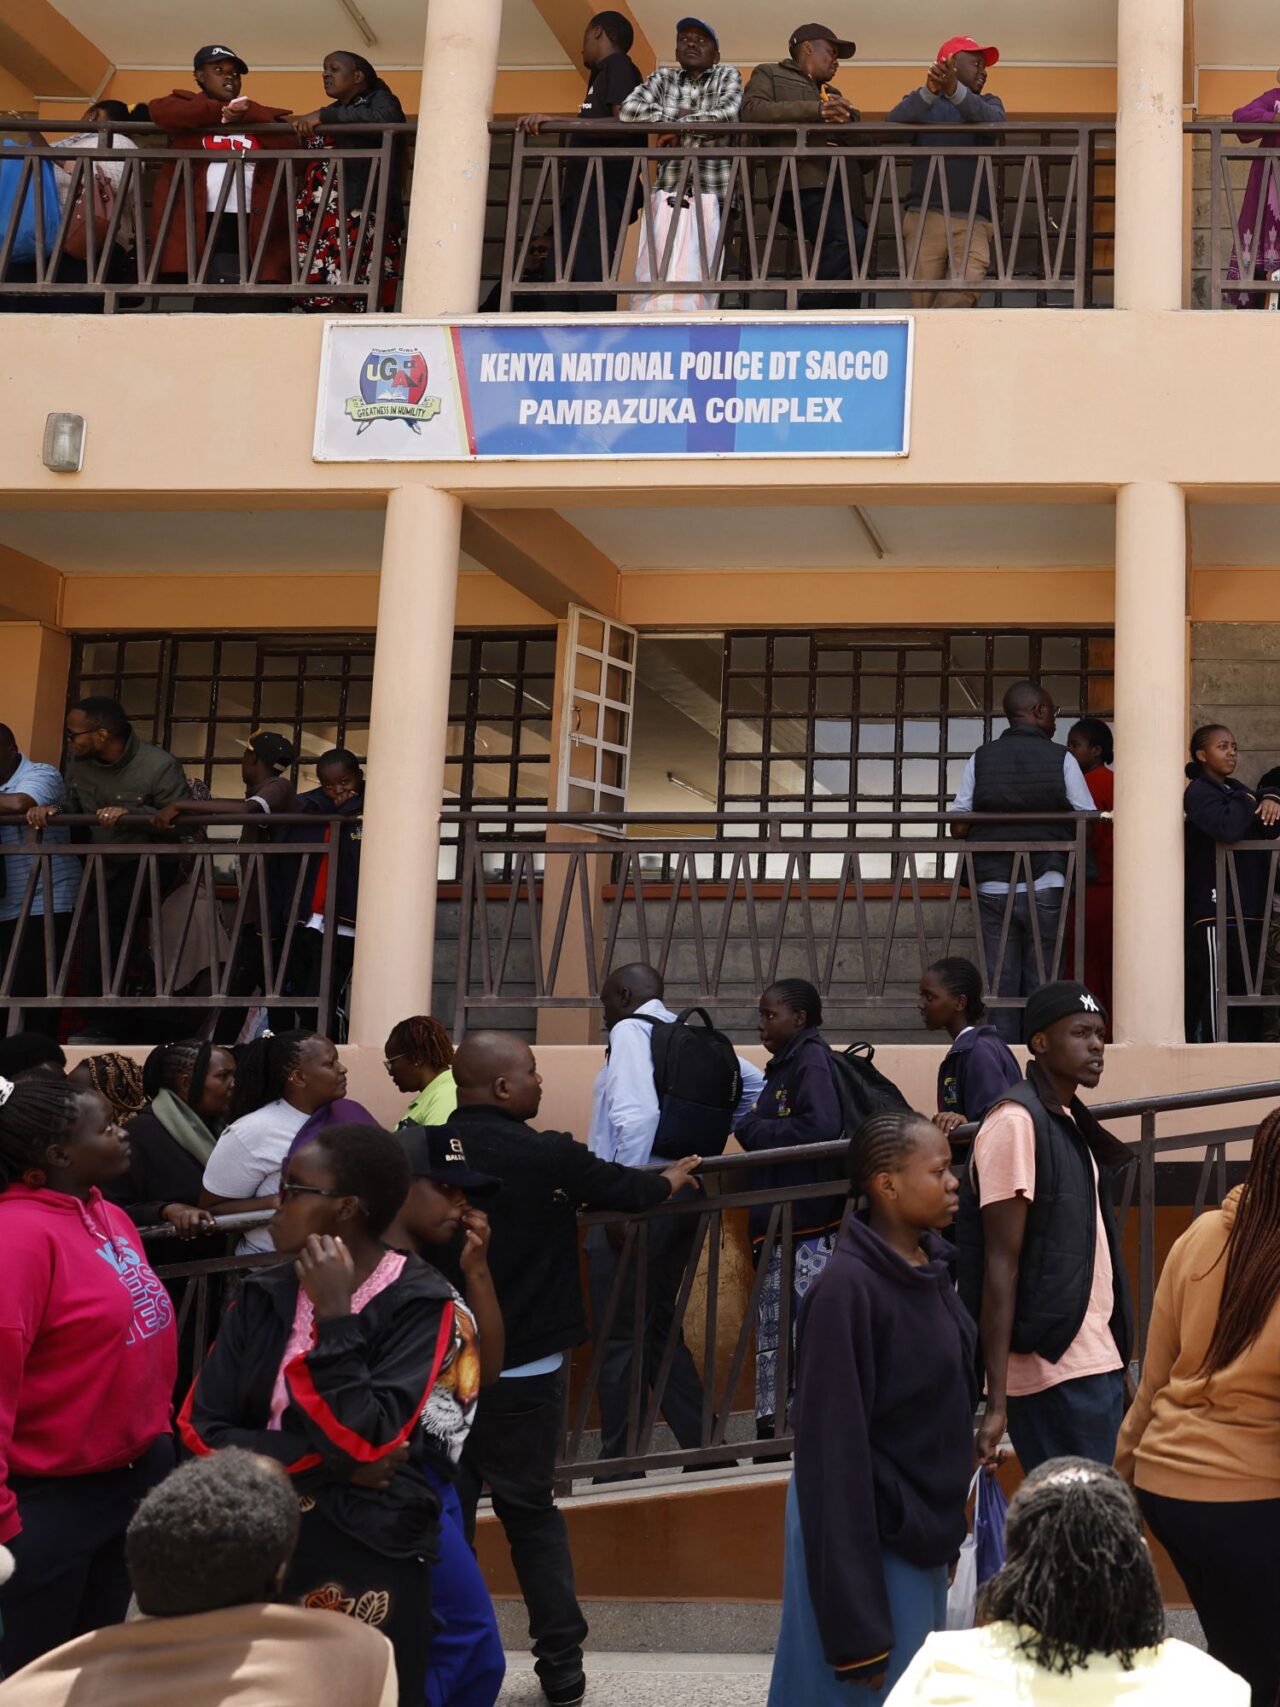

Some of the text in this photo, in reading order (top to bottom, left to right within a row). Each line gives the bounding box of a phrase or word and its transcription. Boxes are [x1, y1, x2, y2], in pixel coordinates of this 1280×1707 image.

[480, 350, 889, 382] KENYA NATIONAL POLICE DT SACCO
[357, 406, 426, 417] GREATNESS IN HUMILITY
[519, 397, 843, 425] PAMBAZUKA COMPLEX
